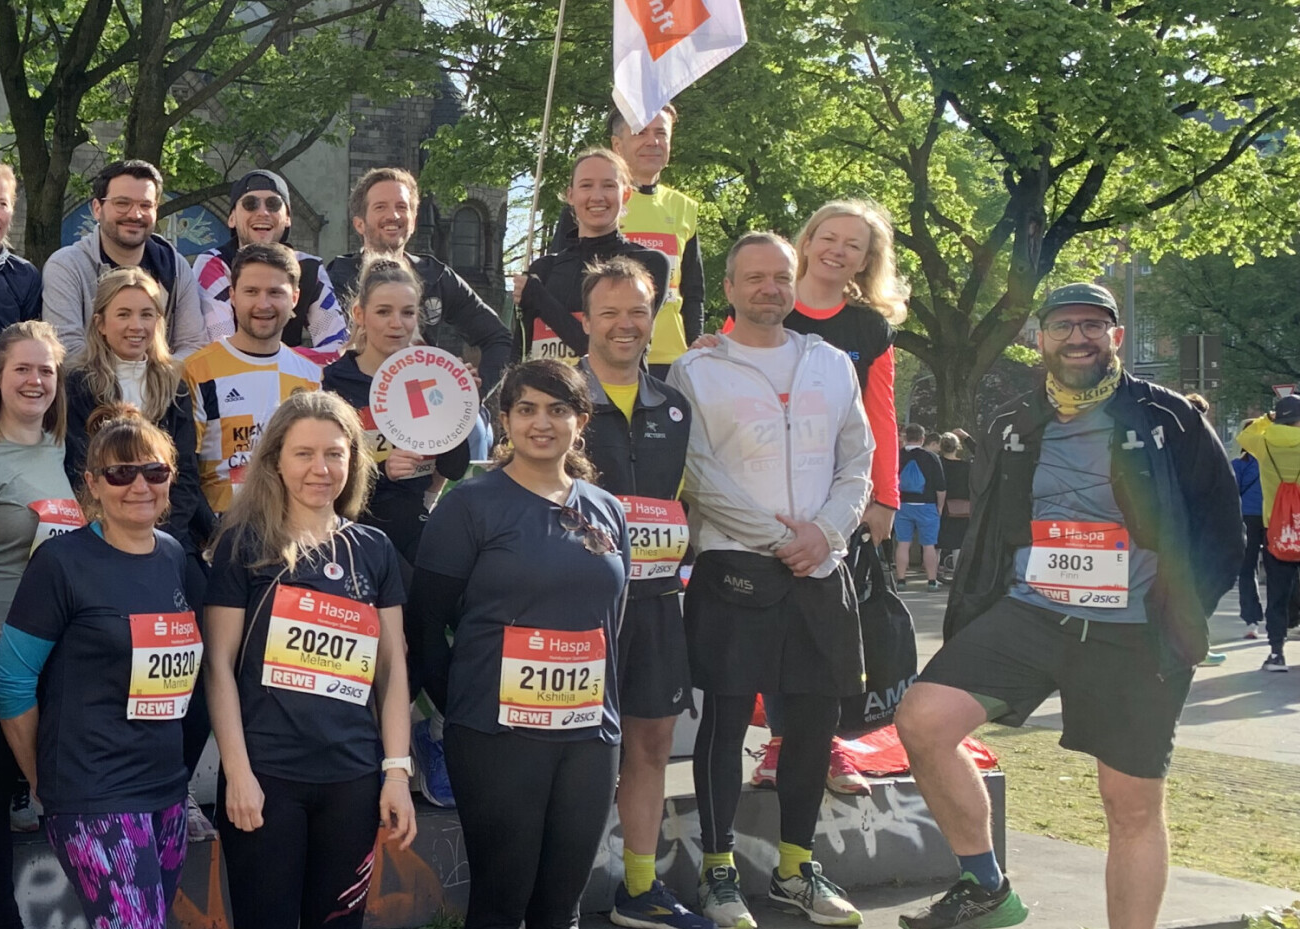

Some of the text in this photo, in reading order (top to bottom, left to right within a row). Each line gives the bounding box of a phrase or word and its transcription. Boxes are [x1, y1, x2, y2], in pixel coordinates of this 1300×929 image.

[373, 349, 472, 414] FriedensSpender
[385, 401, 473, 449] HelpAge Deutschland
[636, 503, 668, 517] Haspa
[1065, 528, 1105, 542] Haspa
[1048, 553, 1094, 572] 3803
[1060, 571, 1079, 580] Finn
[319, 601, 361, 623] Haspa
[171, 621, 194, 637] Haspa
[286, 626, 358, 661] 20207
[549, 638, 591, 655] Haspa
[148, 650, 195, 679] 20320
[361, 659, 369, 673] 3
[272, 670, 314, 688] REWE
[520, 666, 590, 691] 21012
[537, 691, 576, 703] Kshitija
[137, 702, 174, 715] REWE
[509, 708, 550, 724] REWE
